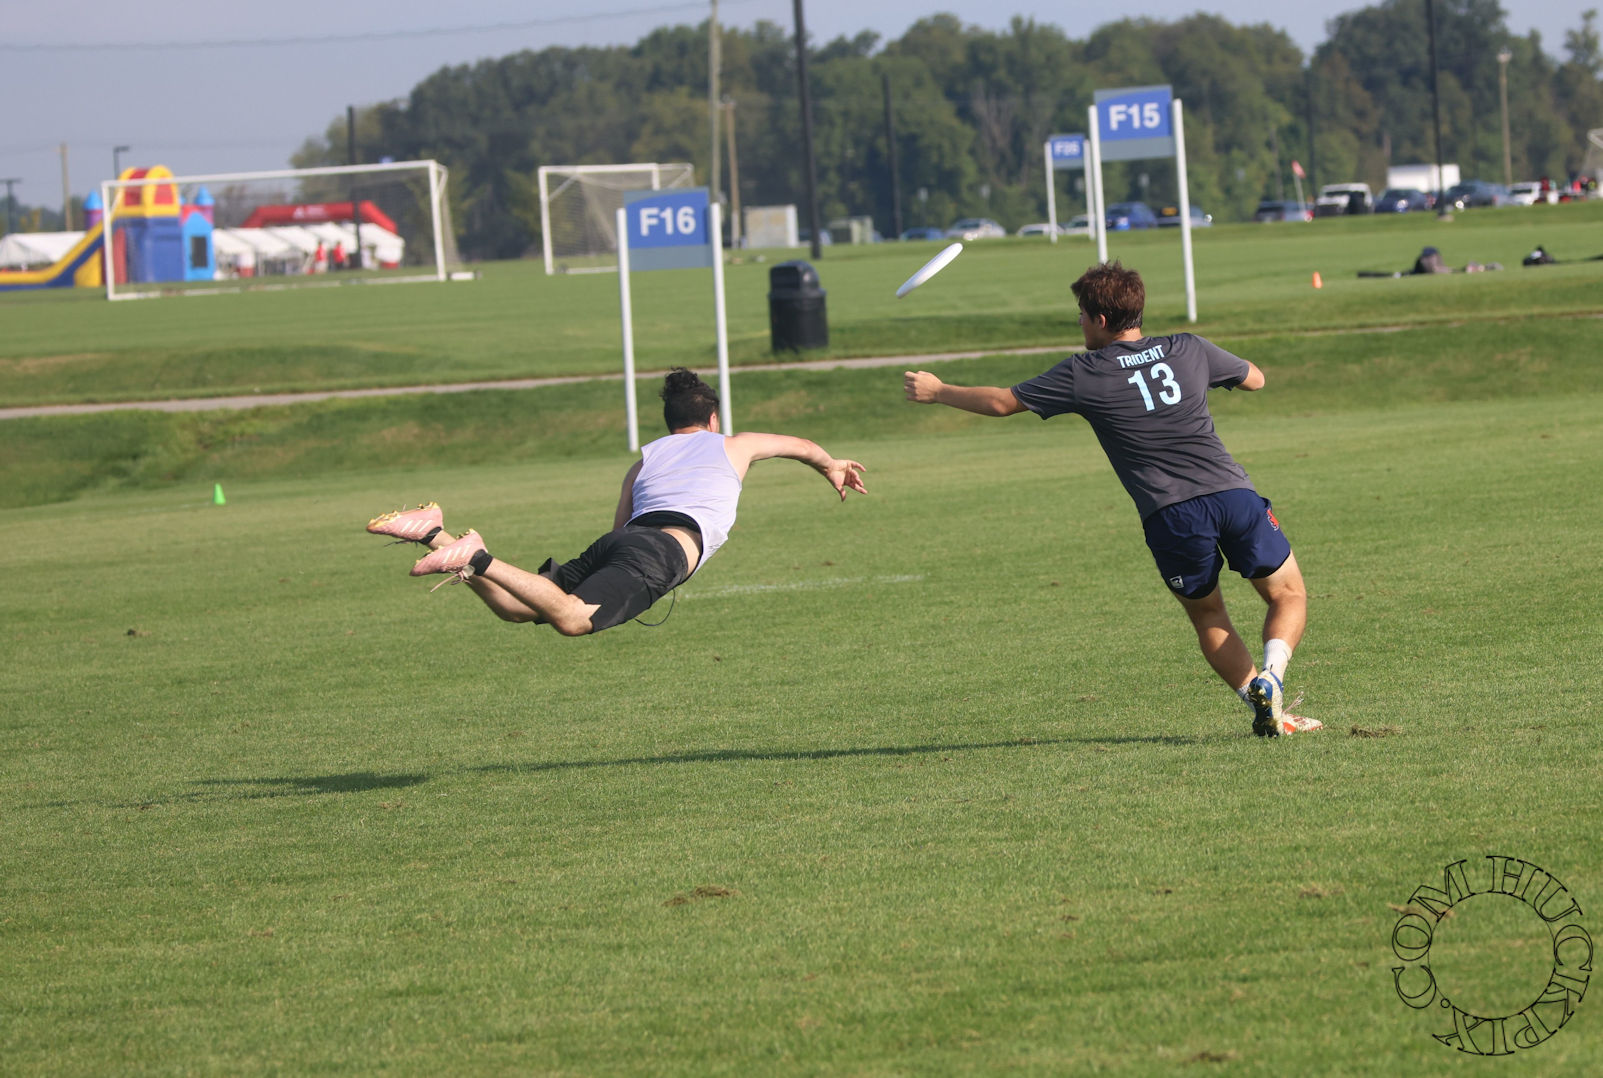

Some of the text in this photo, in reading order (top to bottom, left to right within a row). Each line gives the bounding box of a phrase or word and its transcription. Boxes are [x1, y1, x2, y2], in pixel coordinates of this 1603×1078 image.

[1108, 102, 1162, 131] F15
[639, 206, 697, 237] F16
[1116, 344, 1165, 369] TRIDENT
[1127, 362, 1182, 412] 13
